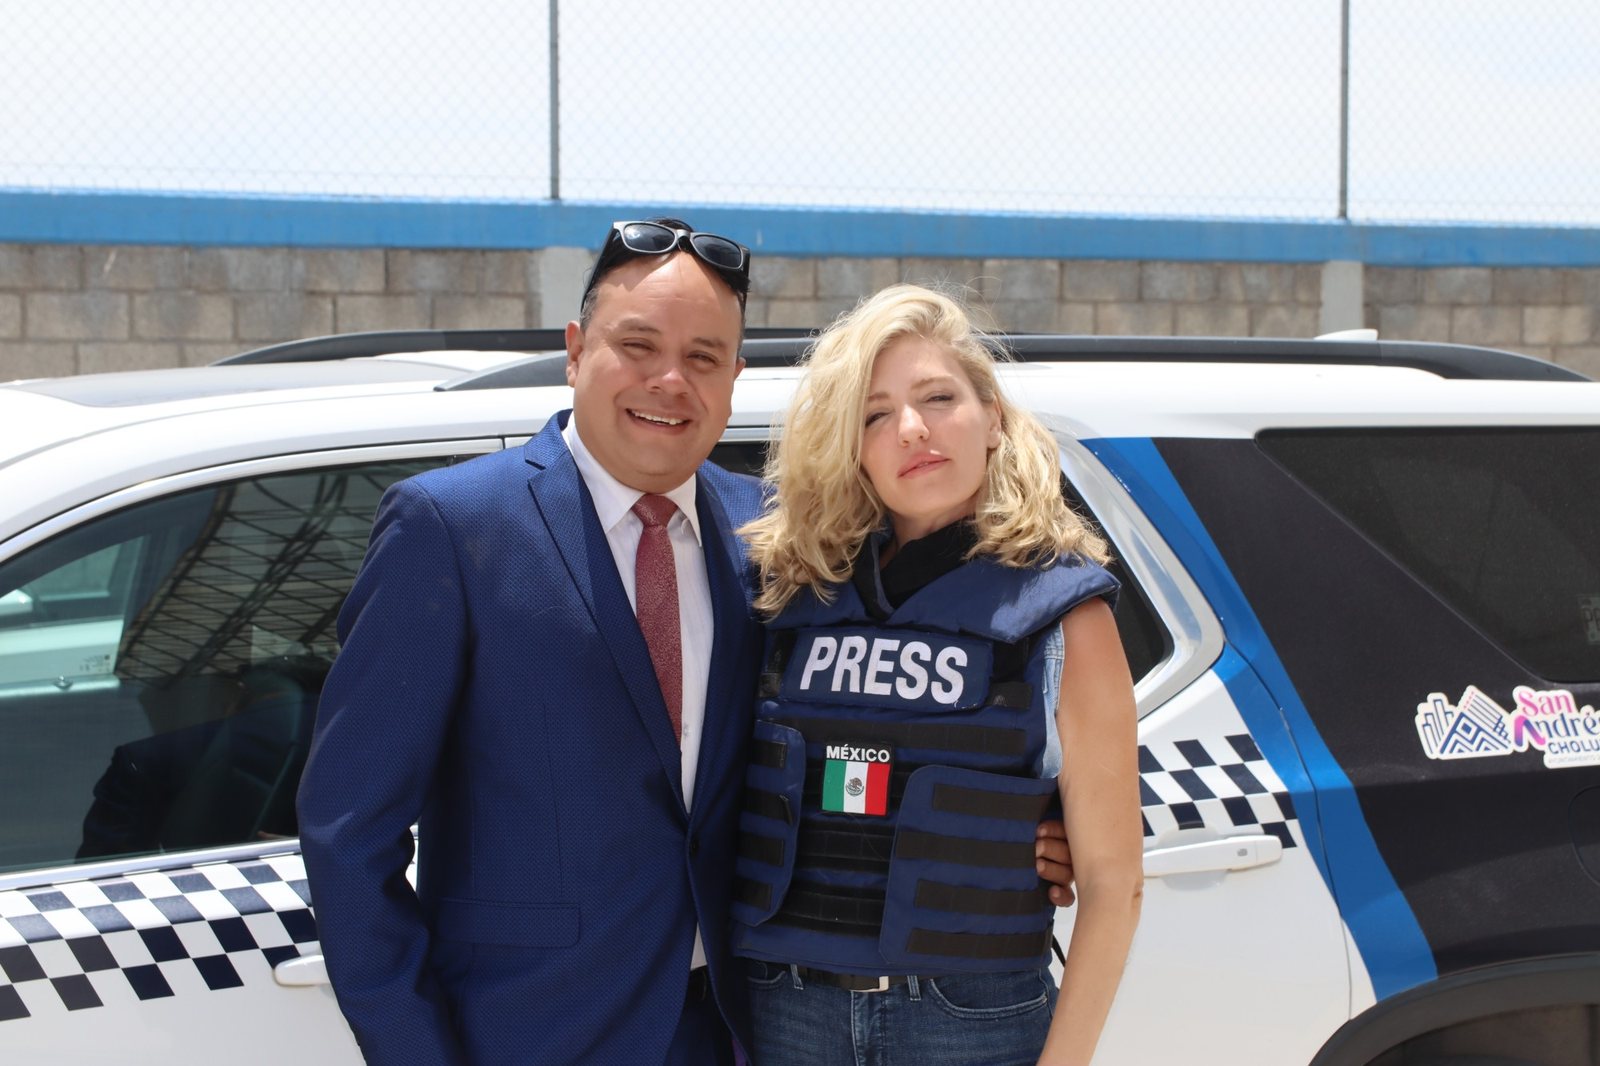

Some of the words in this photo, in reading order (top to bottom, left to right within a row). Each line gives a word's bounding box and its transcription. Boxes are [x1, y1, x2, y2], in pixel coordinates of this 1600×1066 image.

[800, 636, 968, 704] PRESS
[1519, 691, 1572, 717] San
[1514, 712, 1600, 747] André
[826, 744, 890, 762] MÉXICO
